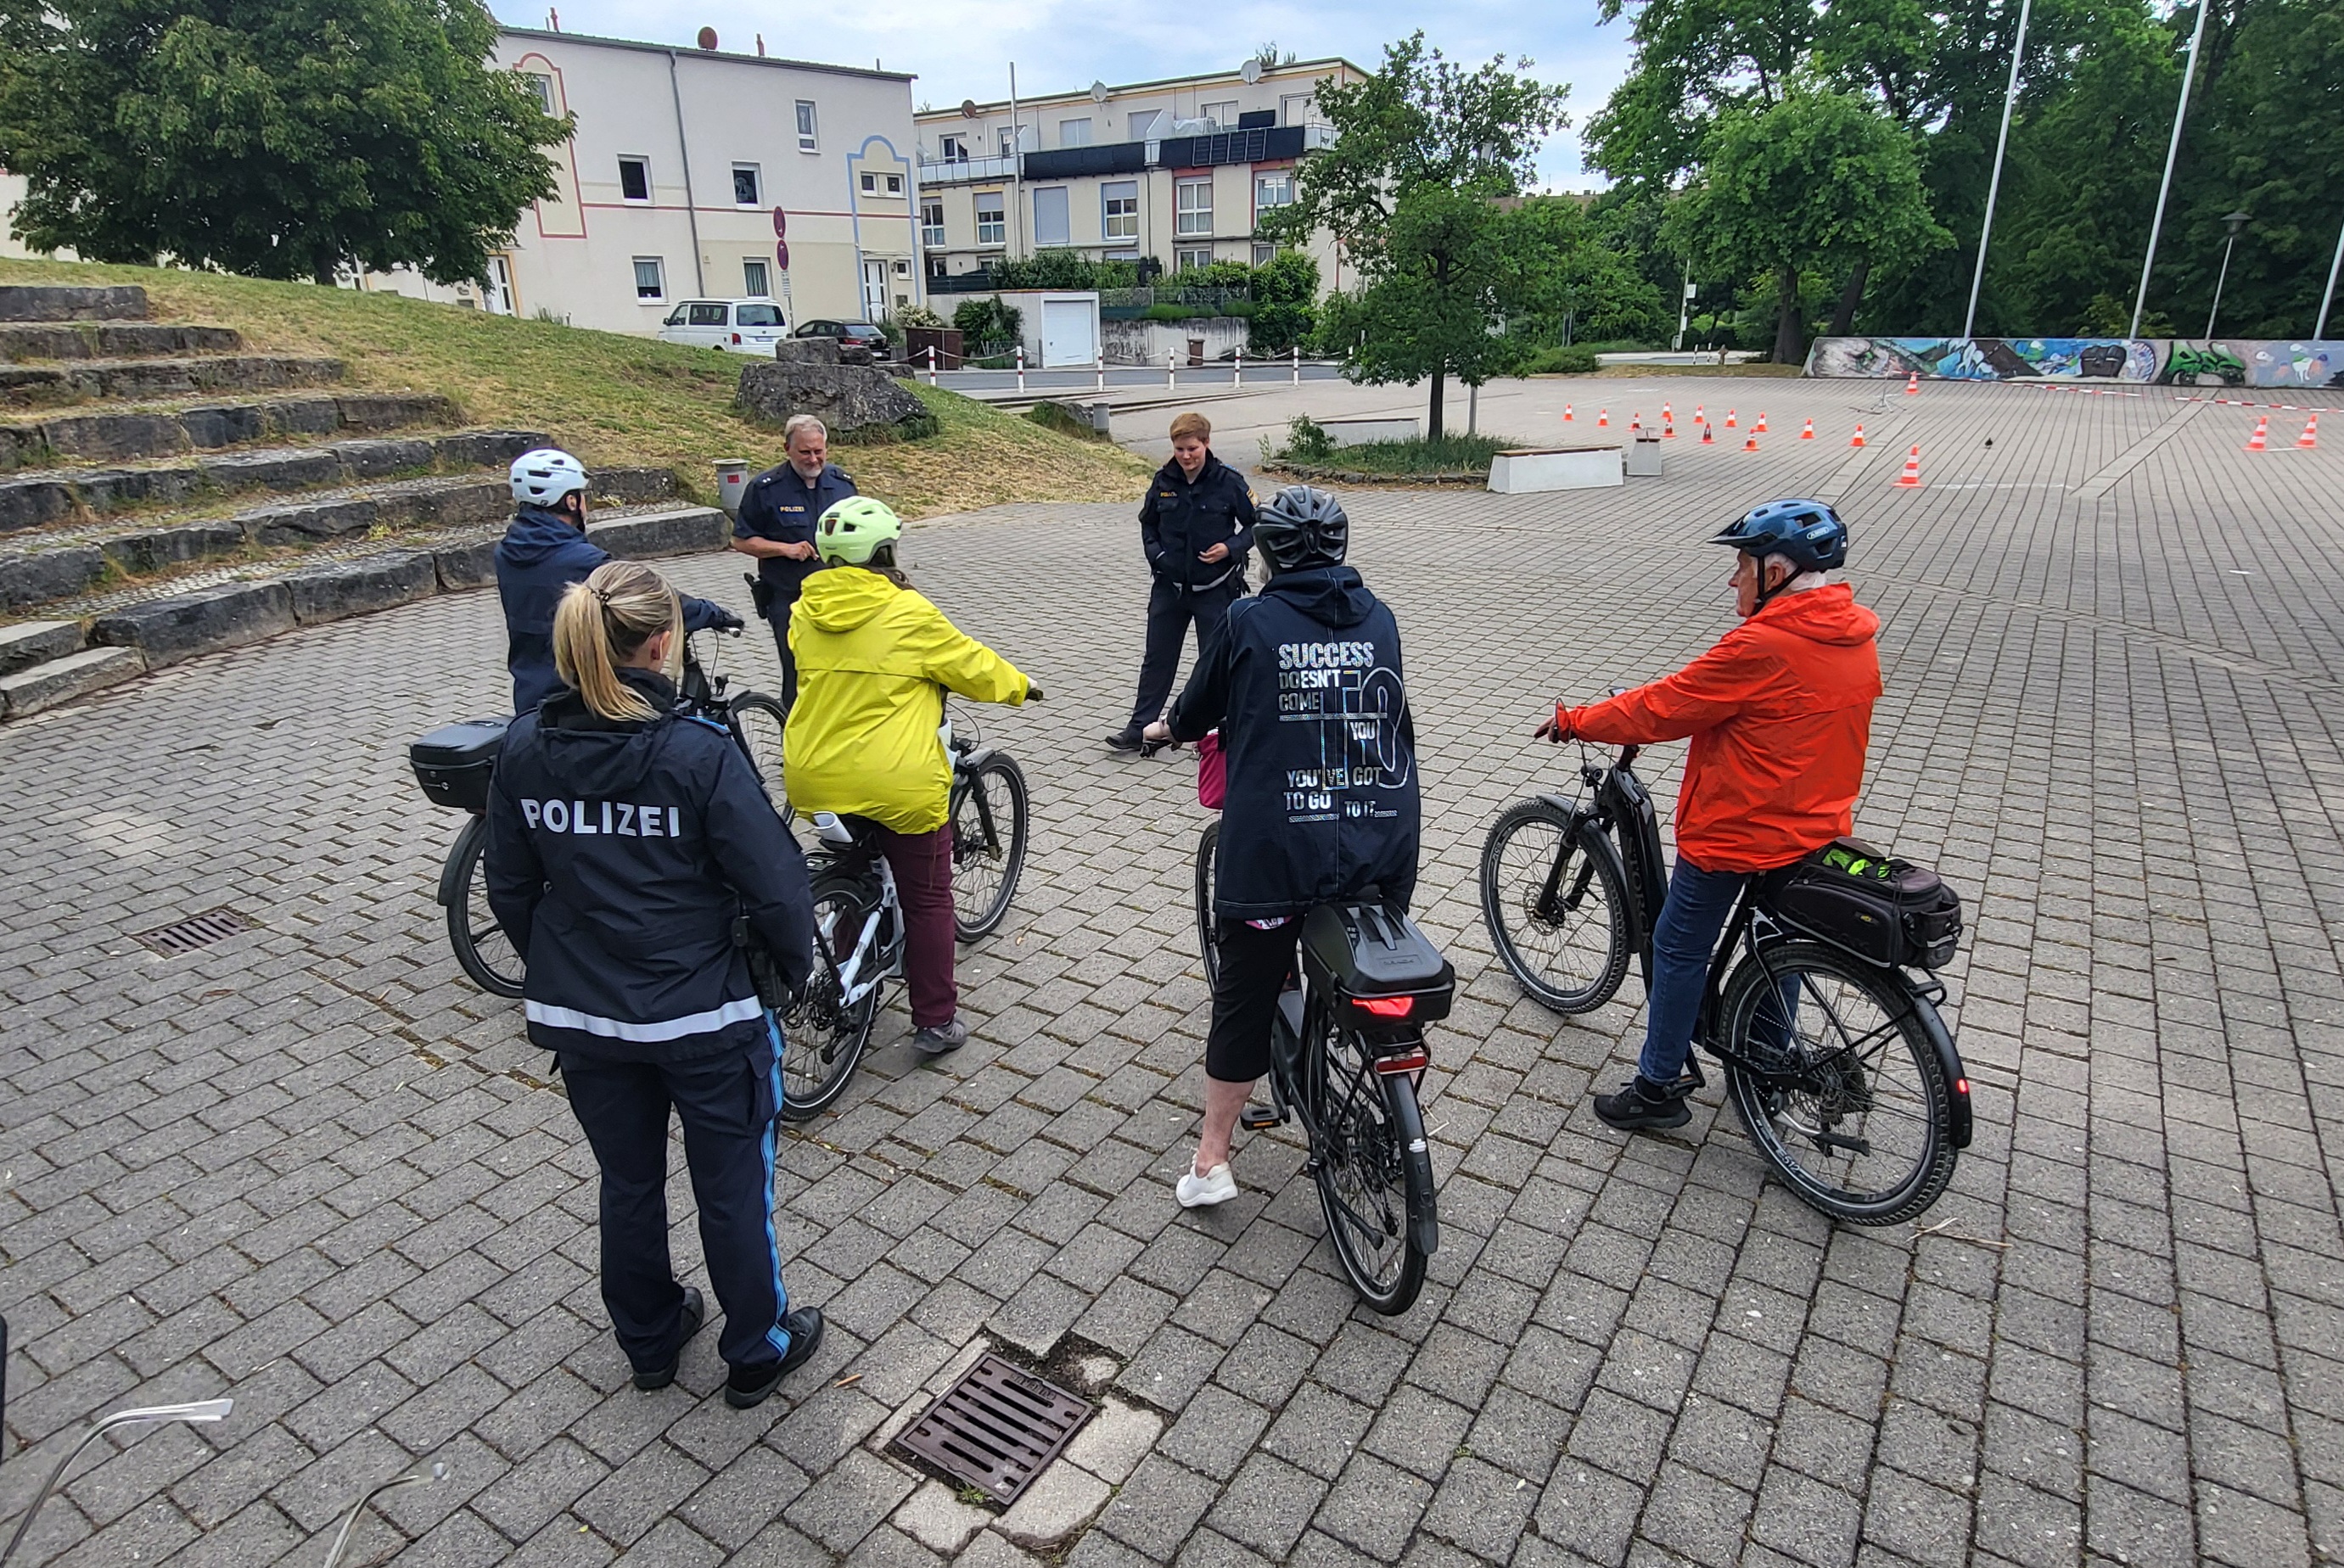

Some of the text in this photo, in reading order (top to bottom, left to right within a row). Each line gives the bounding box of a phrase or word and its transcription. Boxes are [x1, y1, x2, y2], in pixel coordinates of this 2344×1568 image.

[1278, 641, 1375, 669] SUCCESS
[1278, 669, 1341, 689] DOESN'T
[1278, 692, 1320, 711] COME
[1349, 721, 1376, 740] YOU
[1353, 766, 1383, 786] GOT
[1283, 790, 1332, 811] TO GO
[1344, 800, 1361, 817] TO
[520, 798, 680, 837] POLIZEI
